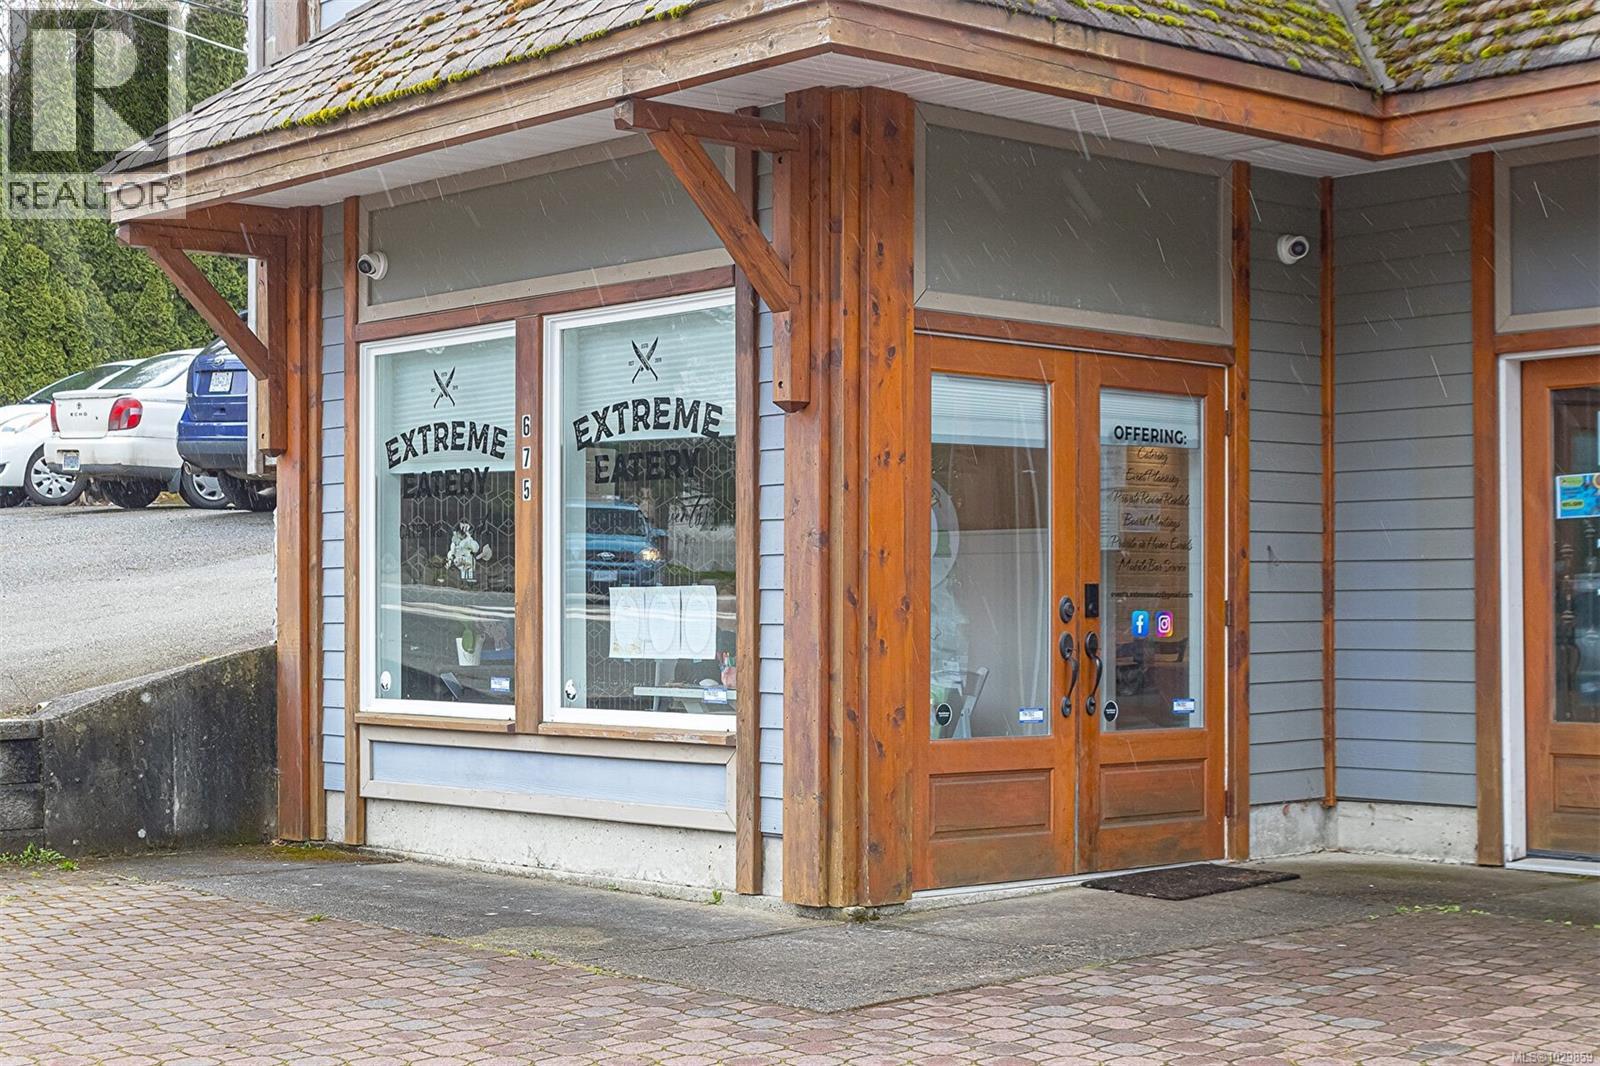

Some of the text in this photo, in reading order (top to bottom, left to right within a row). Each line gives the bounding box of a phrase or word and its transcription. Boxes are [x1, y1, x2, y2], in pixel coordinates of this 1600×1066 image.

[573, 397, 723, 452] EXTREME
[1114, 425, 1188, 446] OFFERING:
[385, 421, 508, 470] EXTREME
[403, 466, 490, 499] EATERY
[594, 448, 701, 484] EATERY
